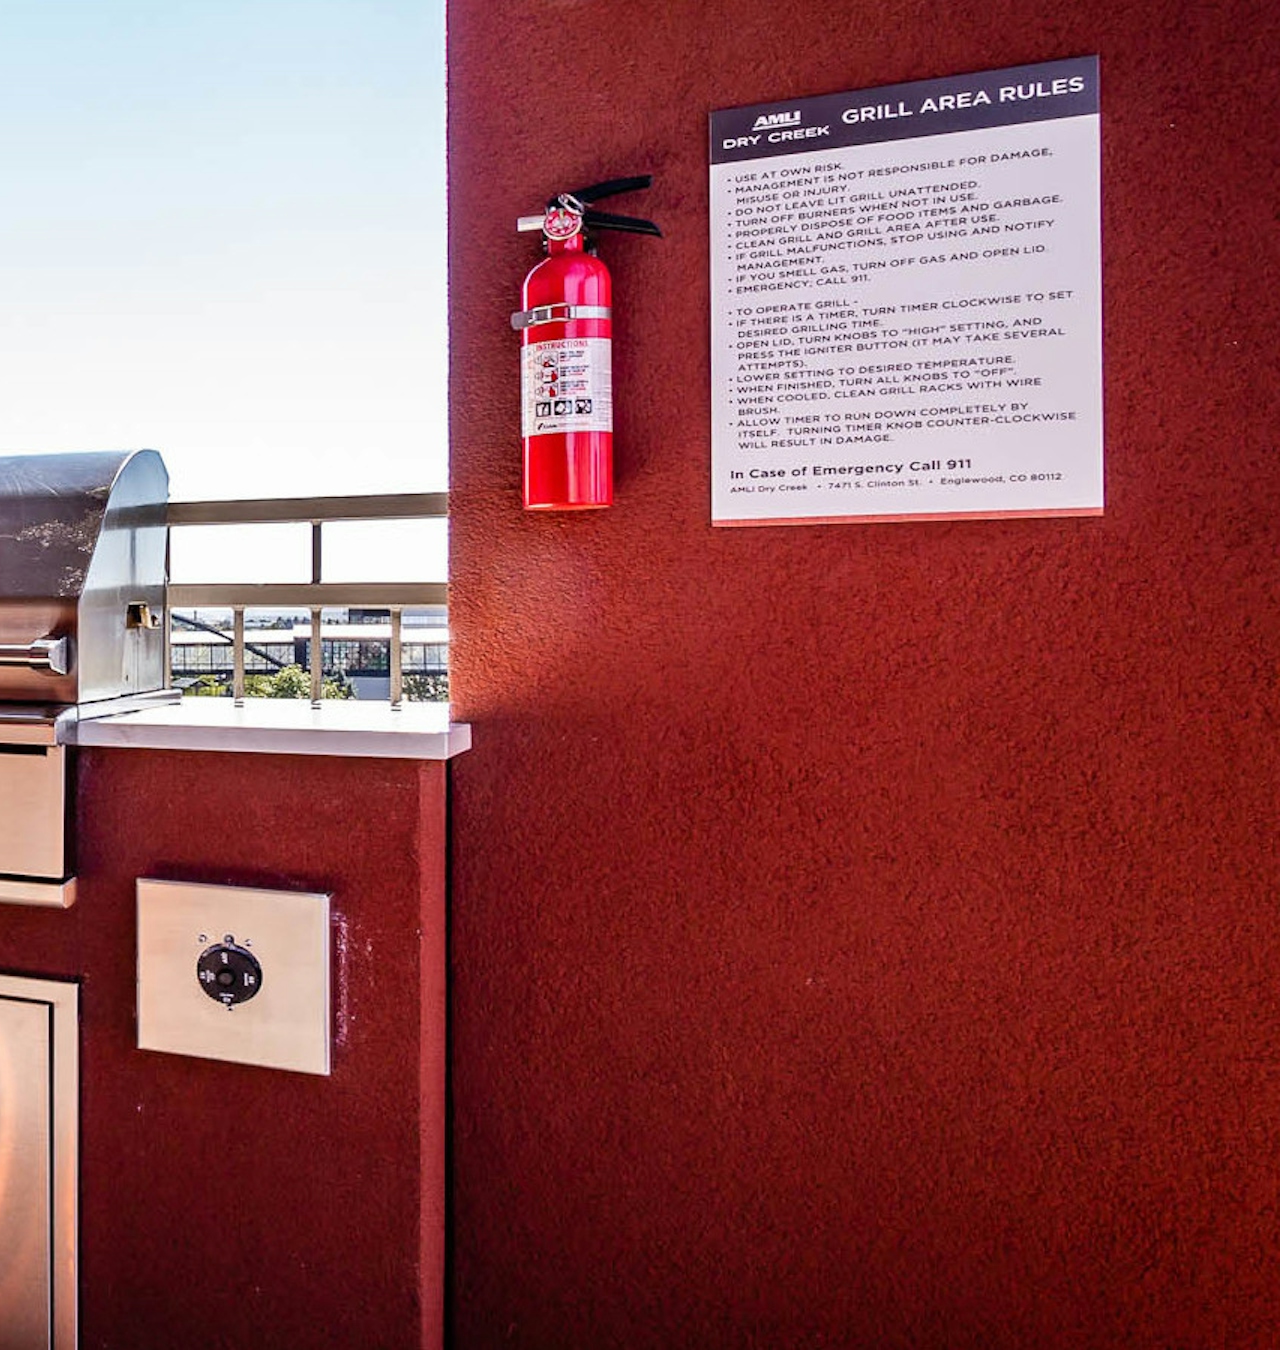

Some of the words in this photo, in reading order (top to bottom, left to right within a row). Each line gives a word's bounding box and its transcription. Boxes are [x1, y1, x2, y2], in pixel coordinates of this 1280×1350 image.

[842, 102, 913, 123] GRILL
[920, 91, 991, 113] AREA
[1000, 77, 1084, 102] RULES
[754, 111, 800, 126] AMLI
[723, 135, 760, 149] DRY
[768, 125, 829, 142] CREEK
[735, 173, 757, 183] USE
[761, 170, 777, 180] AT
[780, 166, 811, 177] OWN
[735, 176, 820, 194] MANAGEMENT
[823, 174, 835, 183] IS
[838, 170, 864, 181] NOT
[868, 159, 955, 177] RESPONSIBLE
[959, 155, 987, 166] FOR
[735, 207, 753, 217] DO
[756, 203, 781, 214] NOT
[784, 198, 824, 211] LEAVE
[828, 195, 846, 205] LIT
[849, 191, 885, 203] GRILL
[736, 193, 778, 205] MISUSE
[782, 190, 800, 200] OR
[735, 217, 767, 227] TURN
[770, 214, 794, 223] OFF
[798, 206, 855, 220] BURNERS
[859, 201, 899, 213] WHEN
[901, 197, 929, 208] NOT
[932, 196, 946, 204] IN
[735, 224, 797, 238] PROPERLY
[801, 218, 853, 231] DISPOSE
[856, 215, 874, 225] OF
[877, 211, 915, 222] FOOD
[918, 206, 957, 218] ITEMS
[960, 203, 989, 213] AND
[735, 239, 775, 250] CLEAN
[778, 235, 813, 245] GRILL
[816, 230, 843, 241] AND
[846, 227, 882, 237] GRILL
[885, 222, 921, 233] AREA
[924, 217, 967, 228] AFTER
[735, 252, 746, 260] IF
[749, 249, 783, 259] GRILL
[890, 233, 924, 244] STOP
[927, 229, 968, 240] USING
[970, 225, 1000, 235] AND
[1004, 219, 1055, 232] NOTIFY
[736, 274, 746, 283] IF
[750, 272, 775, 281] YOU
[778, 268, 817, 278] SMELL
[852, 260, 886, 271] TURN
[889, 257, 915, 267] OFF
[919, 254, 946, 265] GAS
[949, 251, 979, 261] AND
[982, 247, 1019, 258] OPEN
[815, 277, 847, 286] CALL
[736, 307, 753, 316] TO
[755, 302, 812, 314] OPERATE
[814, 299, 850, 309] GRILL
[736, 319, 747, 327] IF
[750, 315, 788, 326] THERE
[792, 314, 802, 322] IS
[805, 313, 814, 321] A
[862, 306, 896, 316] TURN
[900, 302, 938, 313] TIMER
[941, 295, 1021, 309] CLOCKWISE
[1025, 293, 1044, 303] TO
[1048, 290, 1073, 300] SET
[736, 340, 769, 350] OPEN
[798, 335, 830, 344] TURN
[834, 331, 877, 341] KNOBS
[881, 329, 899, 338] TO
[1012, 317, 1042, 327] AND
[737, 327, 788, 338] DESIRED
[791, 322, 847, 333] GRILLING
[738, 350, 774, 361] PRESS
[778, 348, 800, 357] THE
[804, 344, 853, 355] IGNITER
[856, 340, 908, 352] BUTTON
[932, 335, 961, 346] MAY
[965, 332, 999, 343] TAKE
[1003, 328, 1066, 340] SEVERAL
[736, 372, 780, 383] LOWER
[784, 368, 835, 380] SETTING
[838, 367, 855, 375] TO
[858, 362, 913, 374] DESIRED
[736, 385, 773, 394] WHEN
[838, 377, 872, 387] TURN
[876, 375, 899, 384] ALL
[903, 371, 948, 382] KNOBS
[952, 370, 970, 379] TO
[736, 395, 773, 405] WHEN
[834, 389, 876, 399] CLEAN
[879, 386, 916, 395] GRILL
[919, 383, 963, 393] RACKS
[966, 380, 1002, 390] WITH
[1006, 377, 1042, 387] WIRE
[736, 417, 781, 427] ALLOW
[784, 415, 820, 424] TIMER
[824, 413, 841, 422] TO
[844, 412, 871, 421] RUN
[874, 409, 916, 419] DOWN
[919, 403, 1006, 416] COMPLETELY
[1010, 402, 1028, 411] BY
[786, 425, 841, 435] TURNING
[845, 422, 882, 432] TIMER
[886, 420, 923, 430] KNOB
[738, 441, 768, 450] WILL
[771, 437, 816, 448] RESULT
[820, 437, 832, 445] IN
[730, 470, 744, 480] In
[748, 468, 786, 479] Case
[791, 466, 808, 477] of
[812, 464, 904, 476] Emergency
[909, 460, 941, 472] Call
[757, 485, 775, 493] Dry
[778, 484, 807, 492] Creek
[867, 480, 905, 488] Clinton
[1009, 474, 1027, 482] CO
[1030, 472, 1062, 481] 80112
